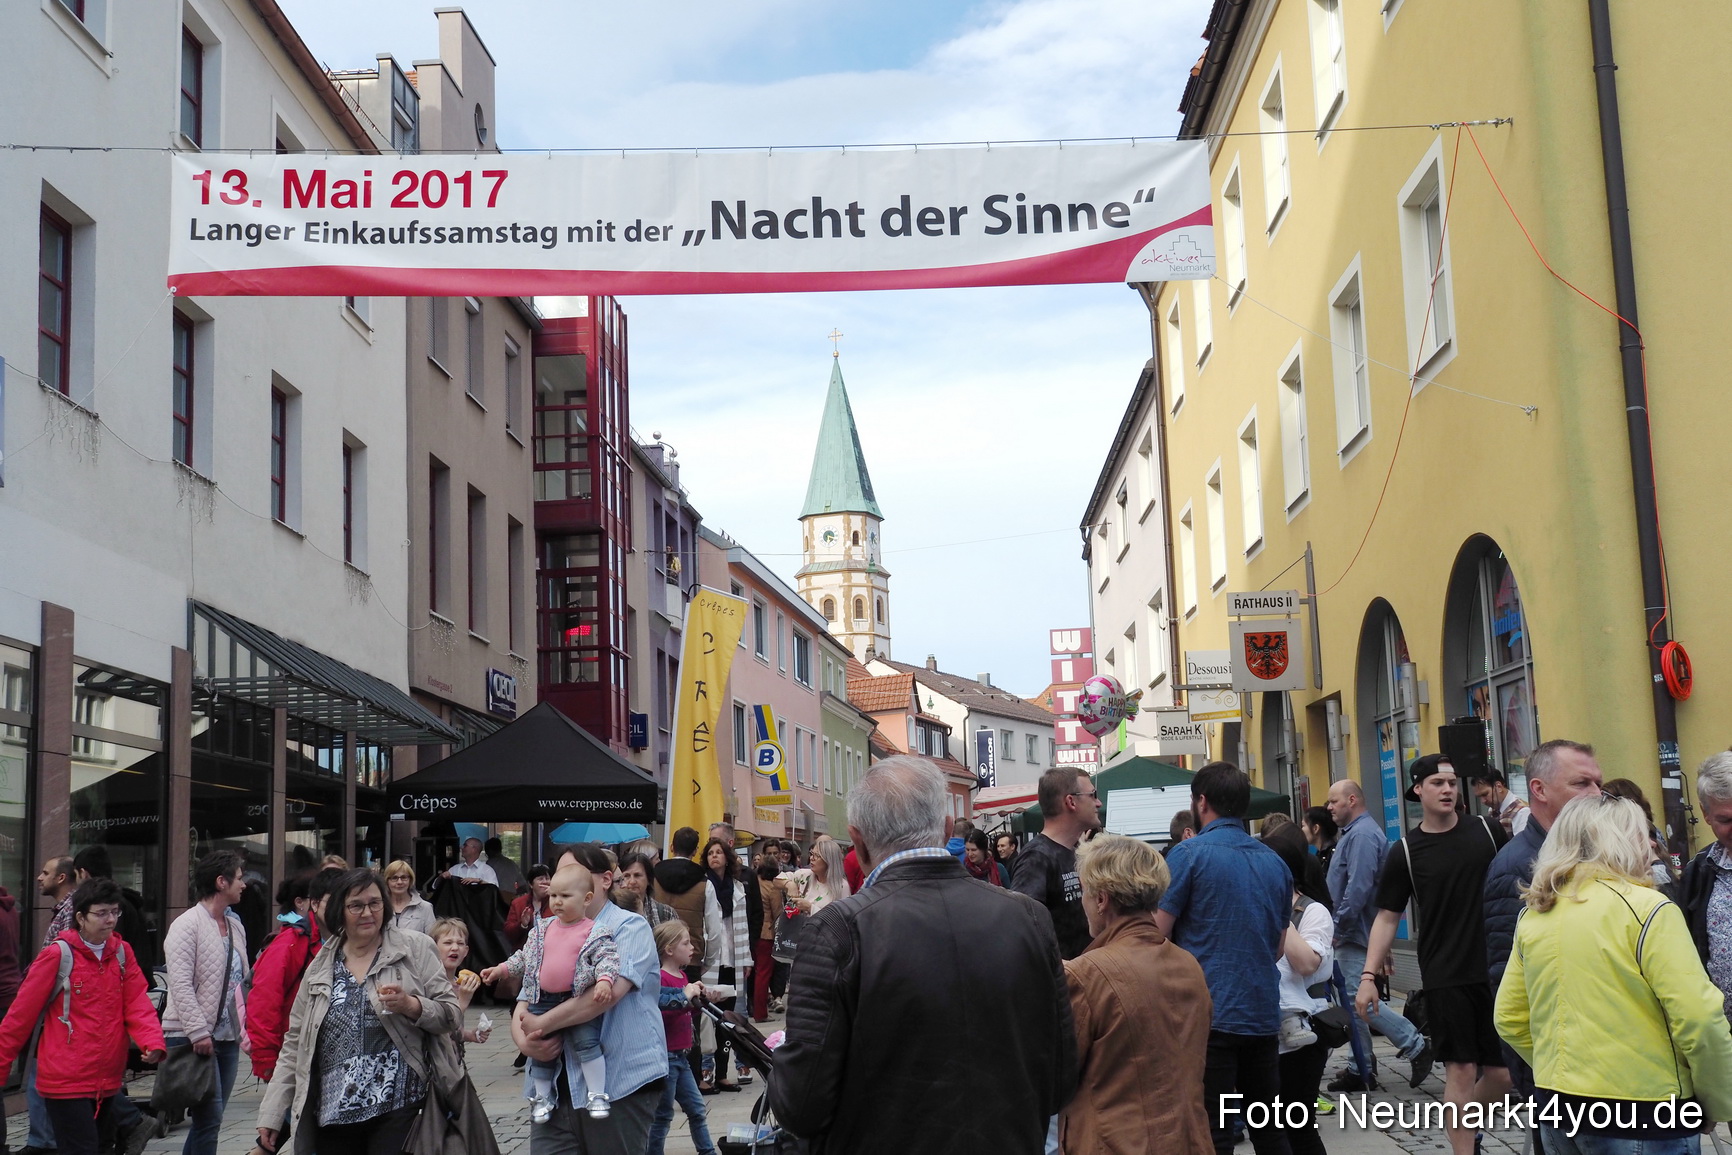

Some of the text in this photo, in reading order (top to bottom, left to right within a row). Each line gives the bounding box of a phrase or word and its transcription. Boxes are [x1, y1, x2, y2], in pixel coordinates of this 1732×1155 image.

[193, 169, 508, 208] 13. Mai 2017
[190, 218, 295, 247] Langer
[305, 219, 557, 249] Einkaufssamstag
[567, 219, 616, 243] mit
[624, 219, 673, 242] der
[682, 196, 865, 246] „Nacht
[881, 194, 967, 237] der
[1169, 263, 1211, 272] Neumarkt
[1235, 597, 1283, 609] RATHAUS
[1052, 630, 1081, 742] WITT
[1160, 724, 1202, 736] SARAH K
[758, 749, 774, 766] B
[1057, 749, 1096, 763] WITT
[400, 794, 457, 813] Crêpes
[538, 798, 642, 811] www.creppresso.de
